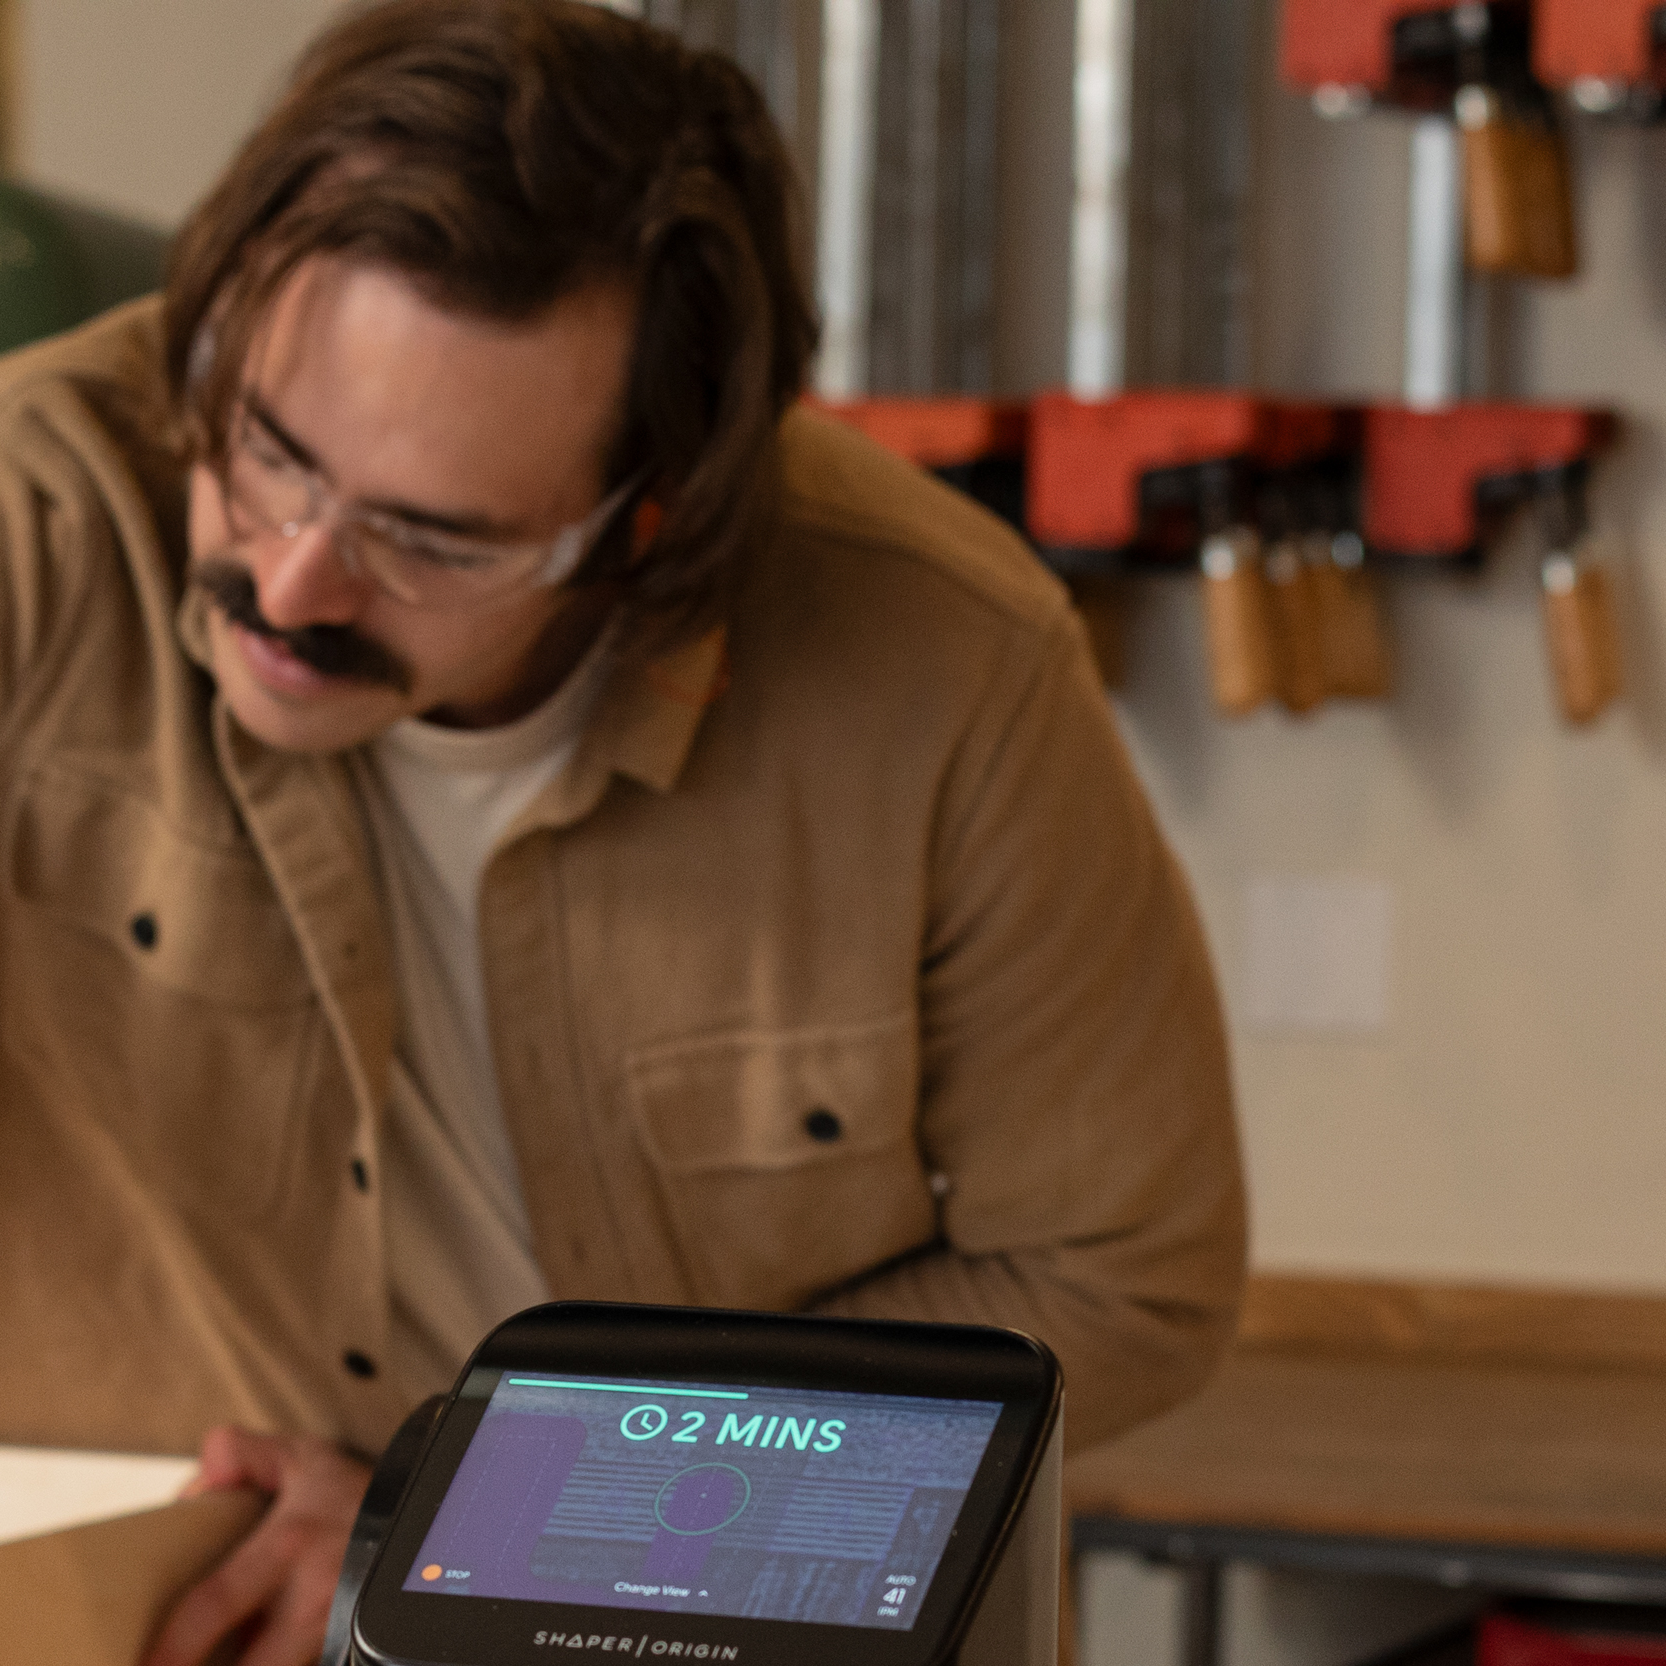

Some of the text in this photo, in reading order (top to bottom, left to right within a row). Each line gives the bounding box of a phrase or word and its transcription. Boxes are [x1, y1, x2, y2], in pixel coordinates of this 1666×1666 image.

[671, 1411, 847, 1453] 2 MINS
[614, 1581, 691, 1597] Change View
[885, 1574, 917, 1586] AUTO
[883, 1587, 907, 1605] 41
[533, 1630, 739, 1661] SHAPER ORIGIN
